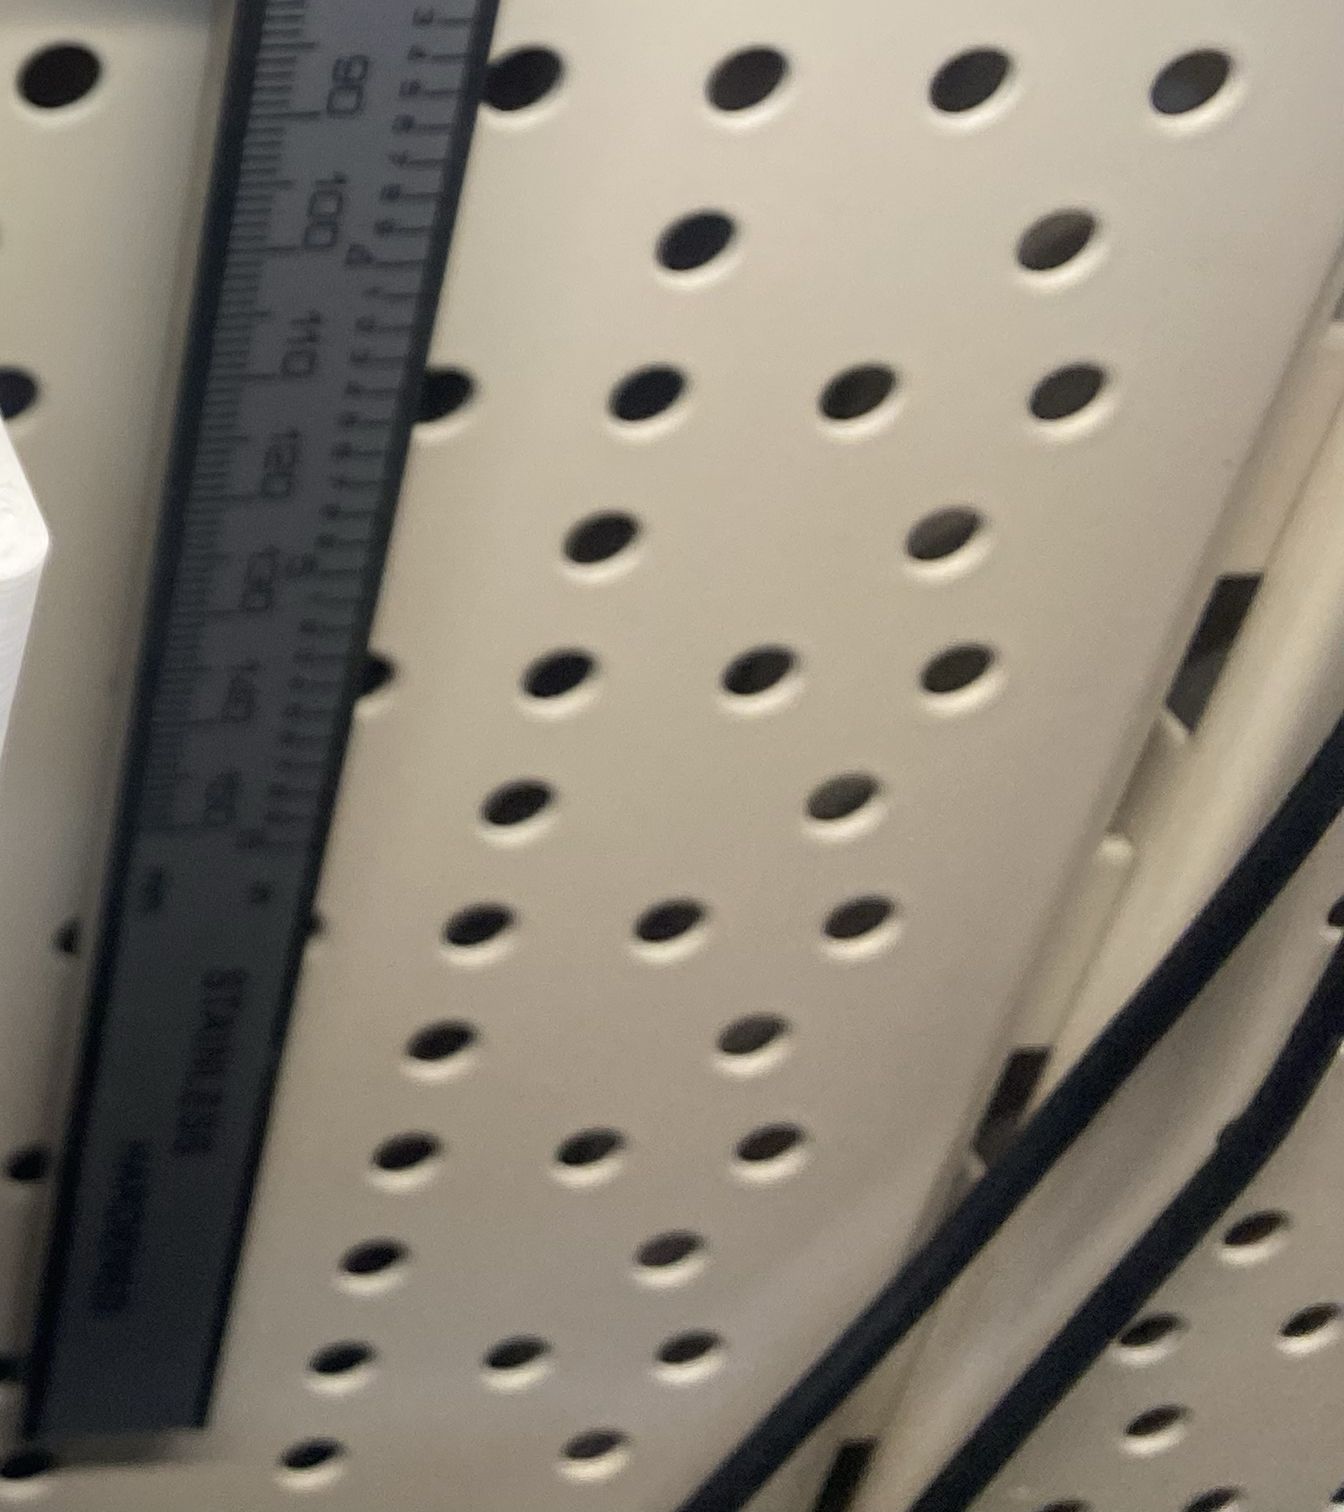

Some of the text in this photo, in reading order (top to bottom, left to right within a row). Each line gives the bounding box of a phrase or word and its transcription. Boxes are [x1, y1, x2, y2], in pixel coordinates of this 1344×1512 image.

[326, 54, 372, 117] 90
[303, 172, 348, 250] 100
[281, 311, 323, 378] 110
[260, 429, 302, 499] 120
